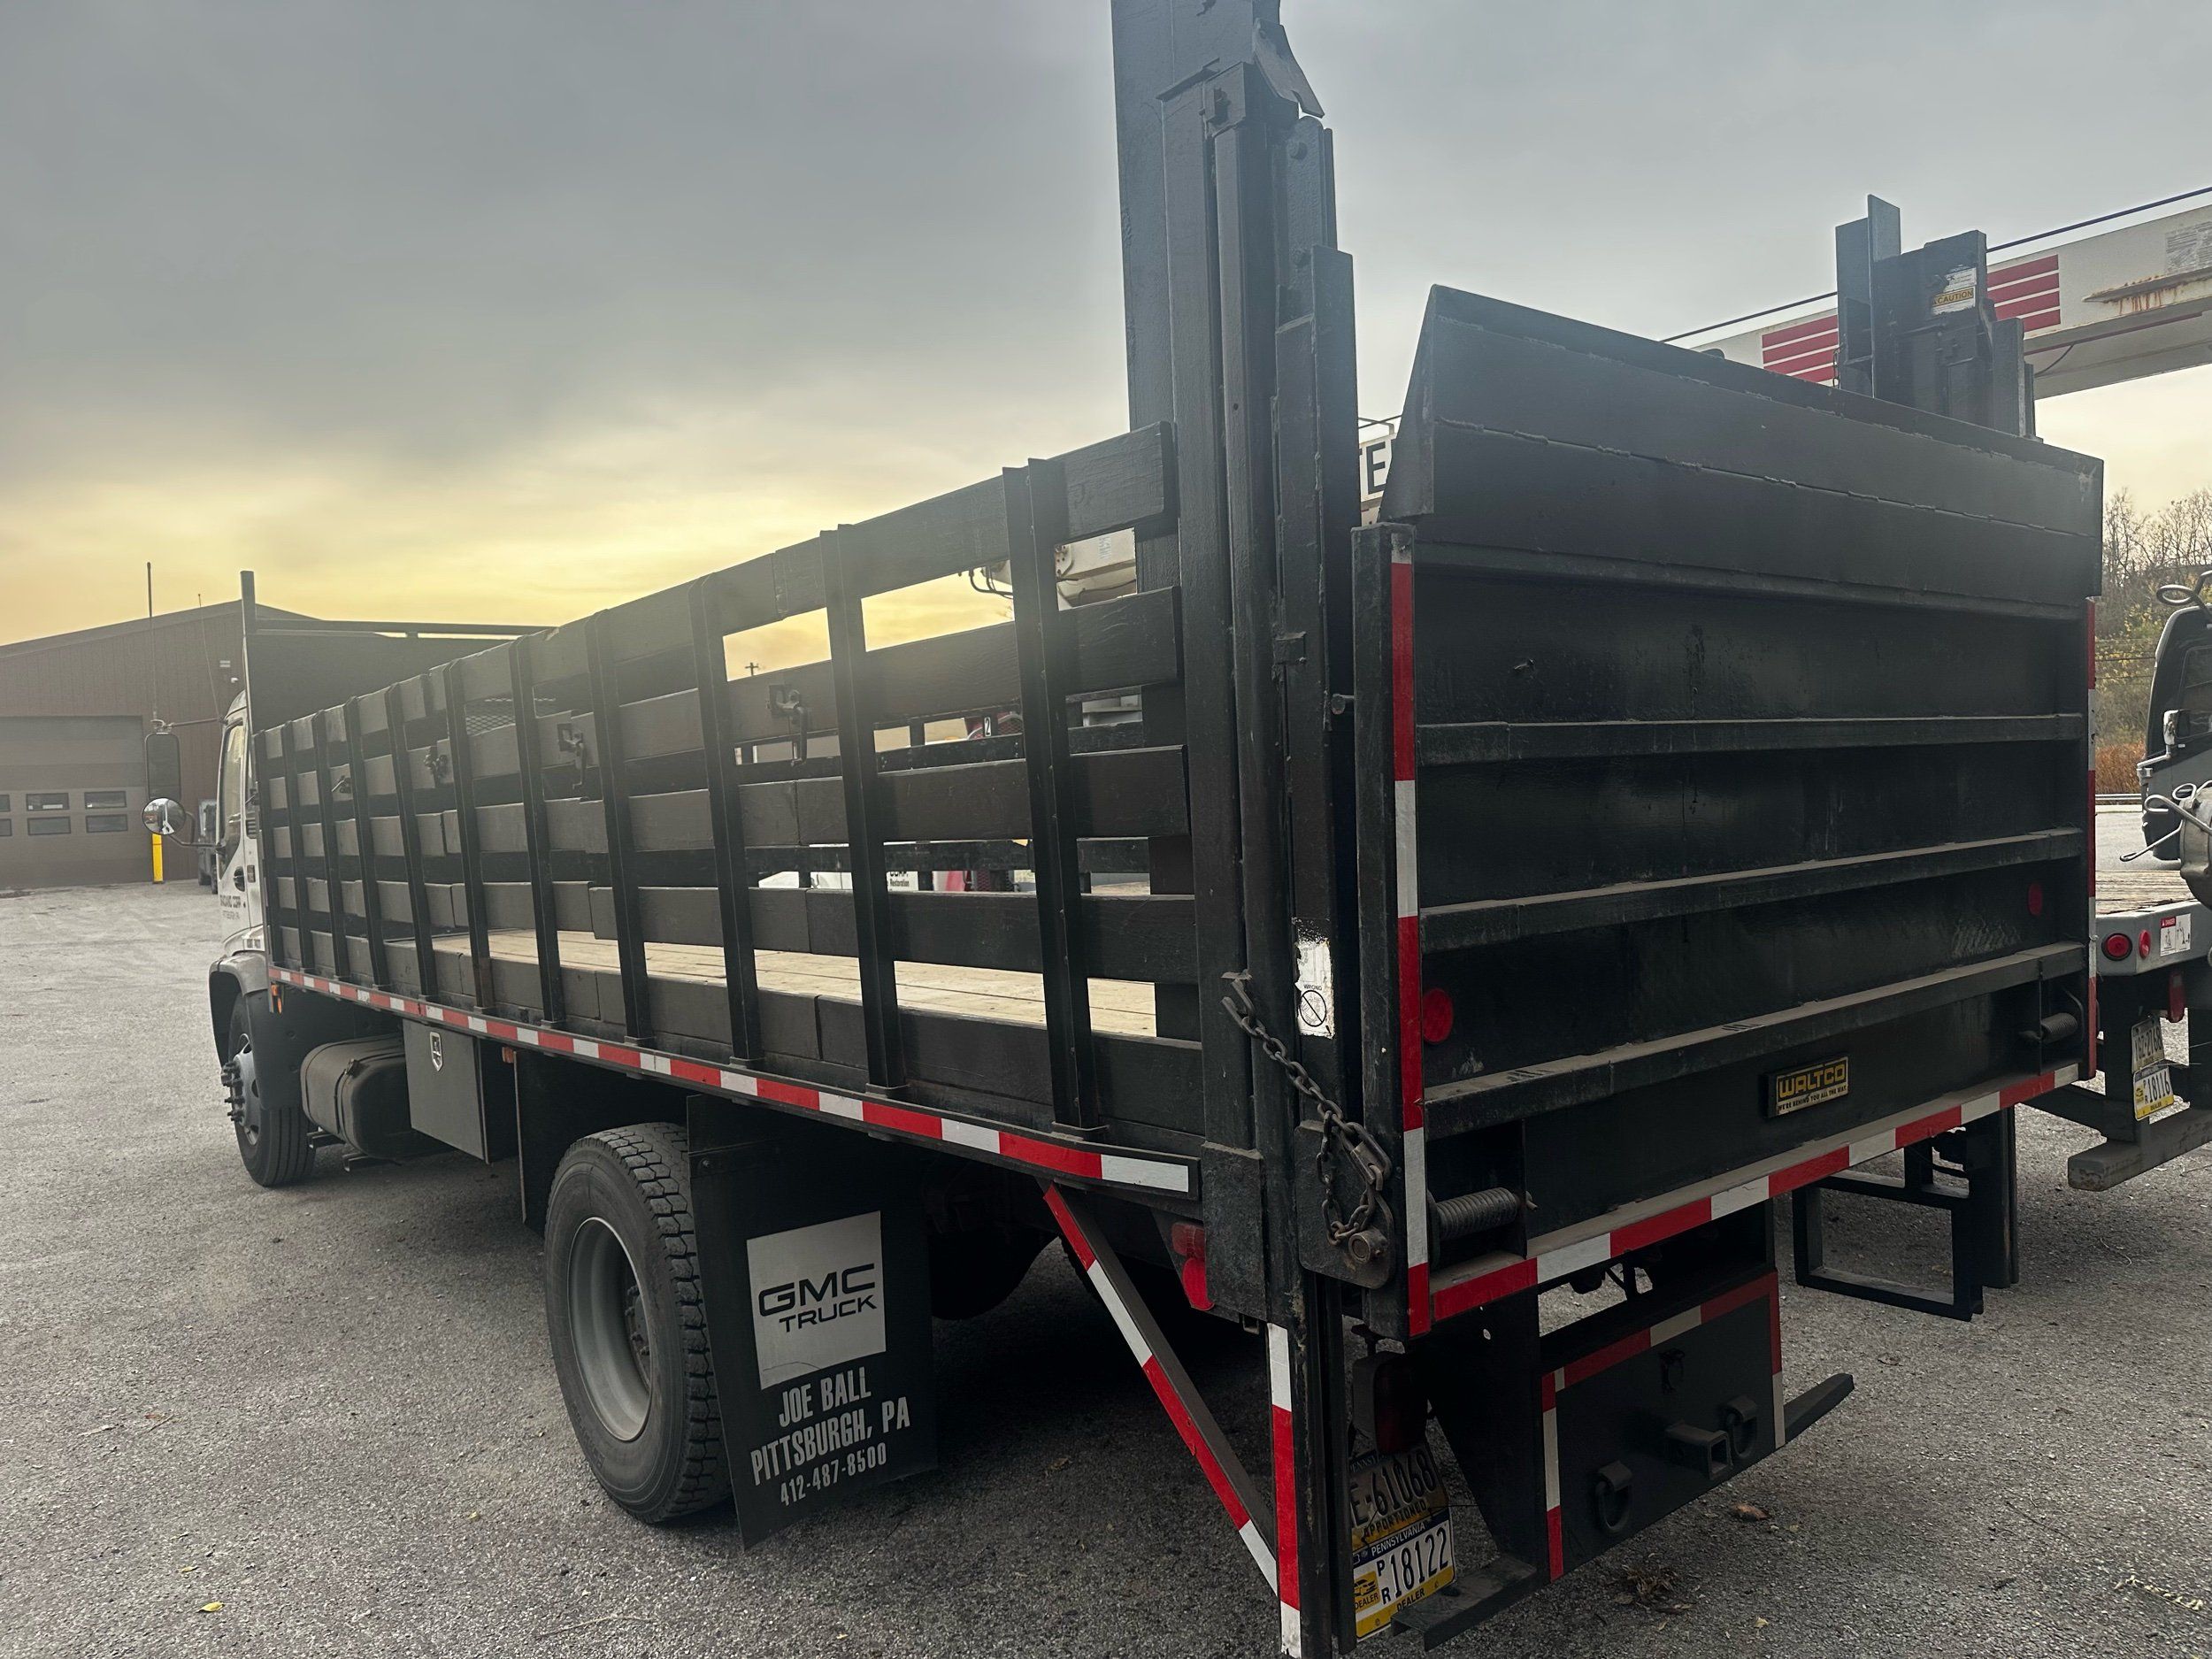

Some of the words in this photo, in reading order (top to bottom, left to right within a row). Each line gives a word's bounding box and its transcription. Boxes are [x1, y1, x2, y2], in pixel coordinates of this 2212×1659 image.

[1938, 289, 1973, 304] CAUTION
[985, 718, 991, 735] 2
[1778, 1064, 1846, 1098] WALTCO
[2147, 1071, 2170, 1103] 18116
[1793, 1095, 1809, 1107] BEHIND
[758, 1263, 876, 1317] GMC
[779, 1294, 878, 1333] TRUCK
[779, 1383, 814, 1428] JOE
[819, 1366, 872, 1413] BALL
[750, 1409, 873, 1486] PITTSBURGH,
[881, 1396, 910, 1434] PA
[780, 1441, 887, 1507] 412-487-8500
[1363, 1499, 1427, 1538] APPORTIONED
[1371, 1523, 1426, 1556] PENNSYLVANIA
[1390, 1526, 1448, 1598] 18122
[1355, 1592, 1379, 1610] DEALER
[1396, 1587, 1425, 1612] DEALER
